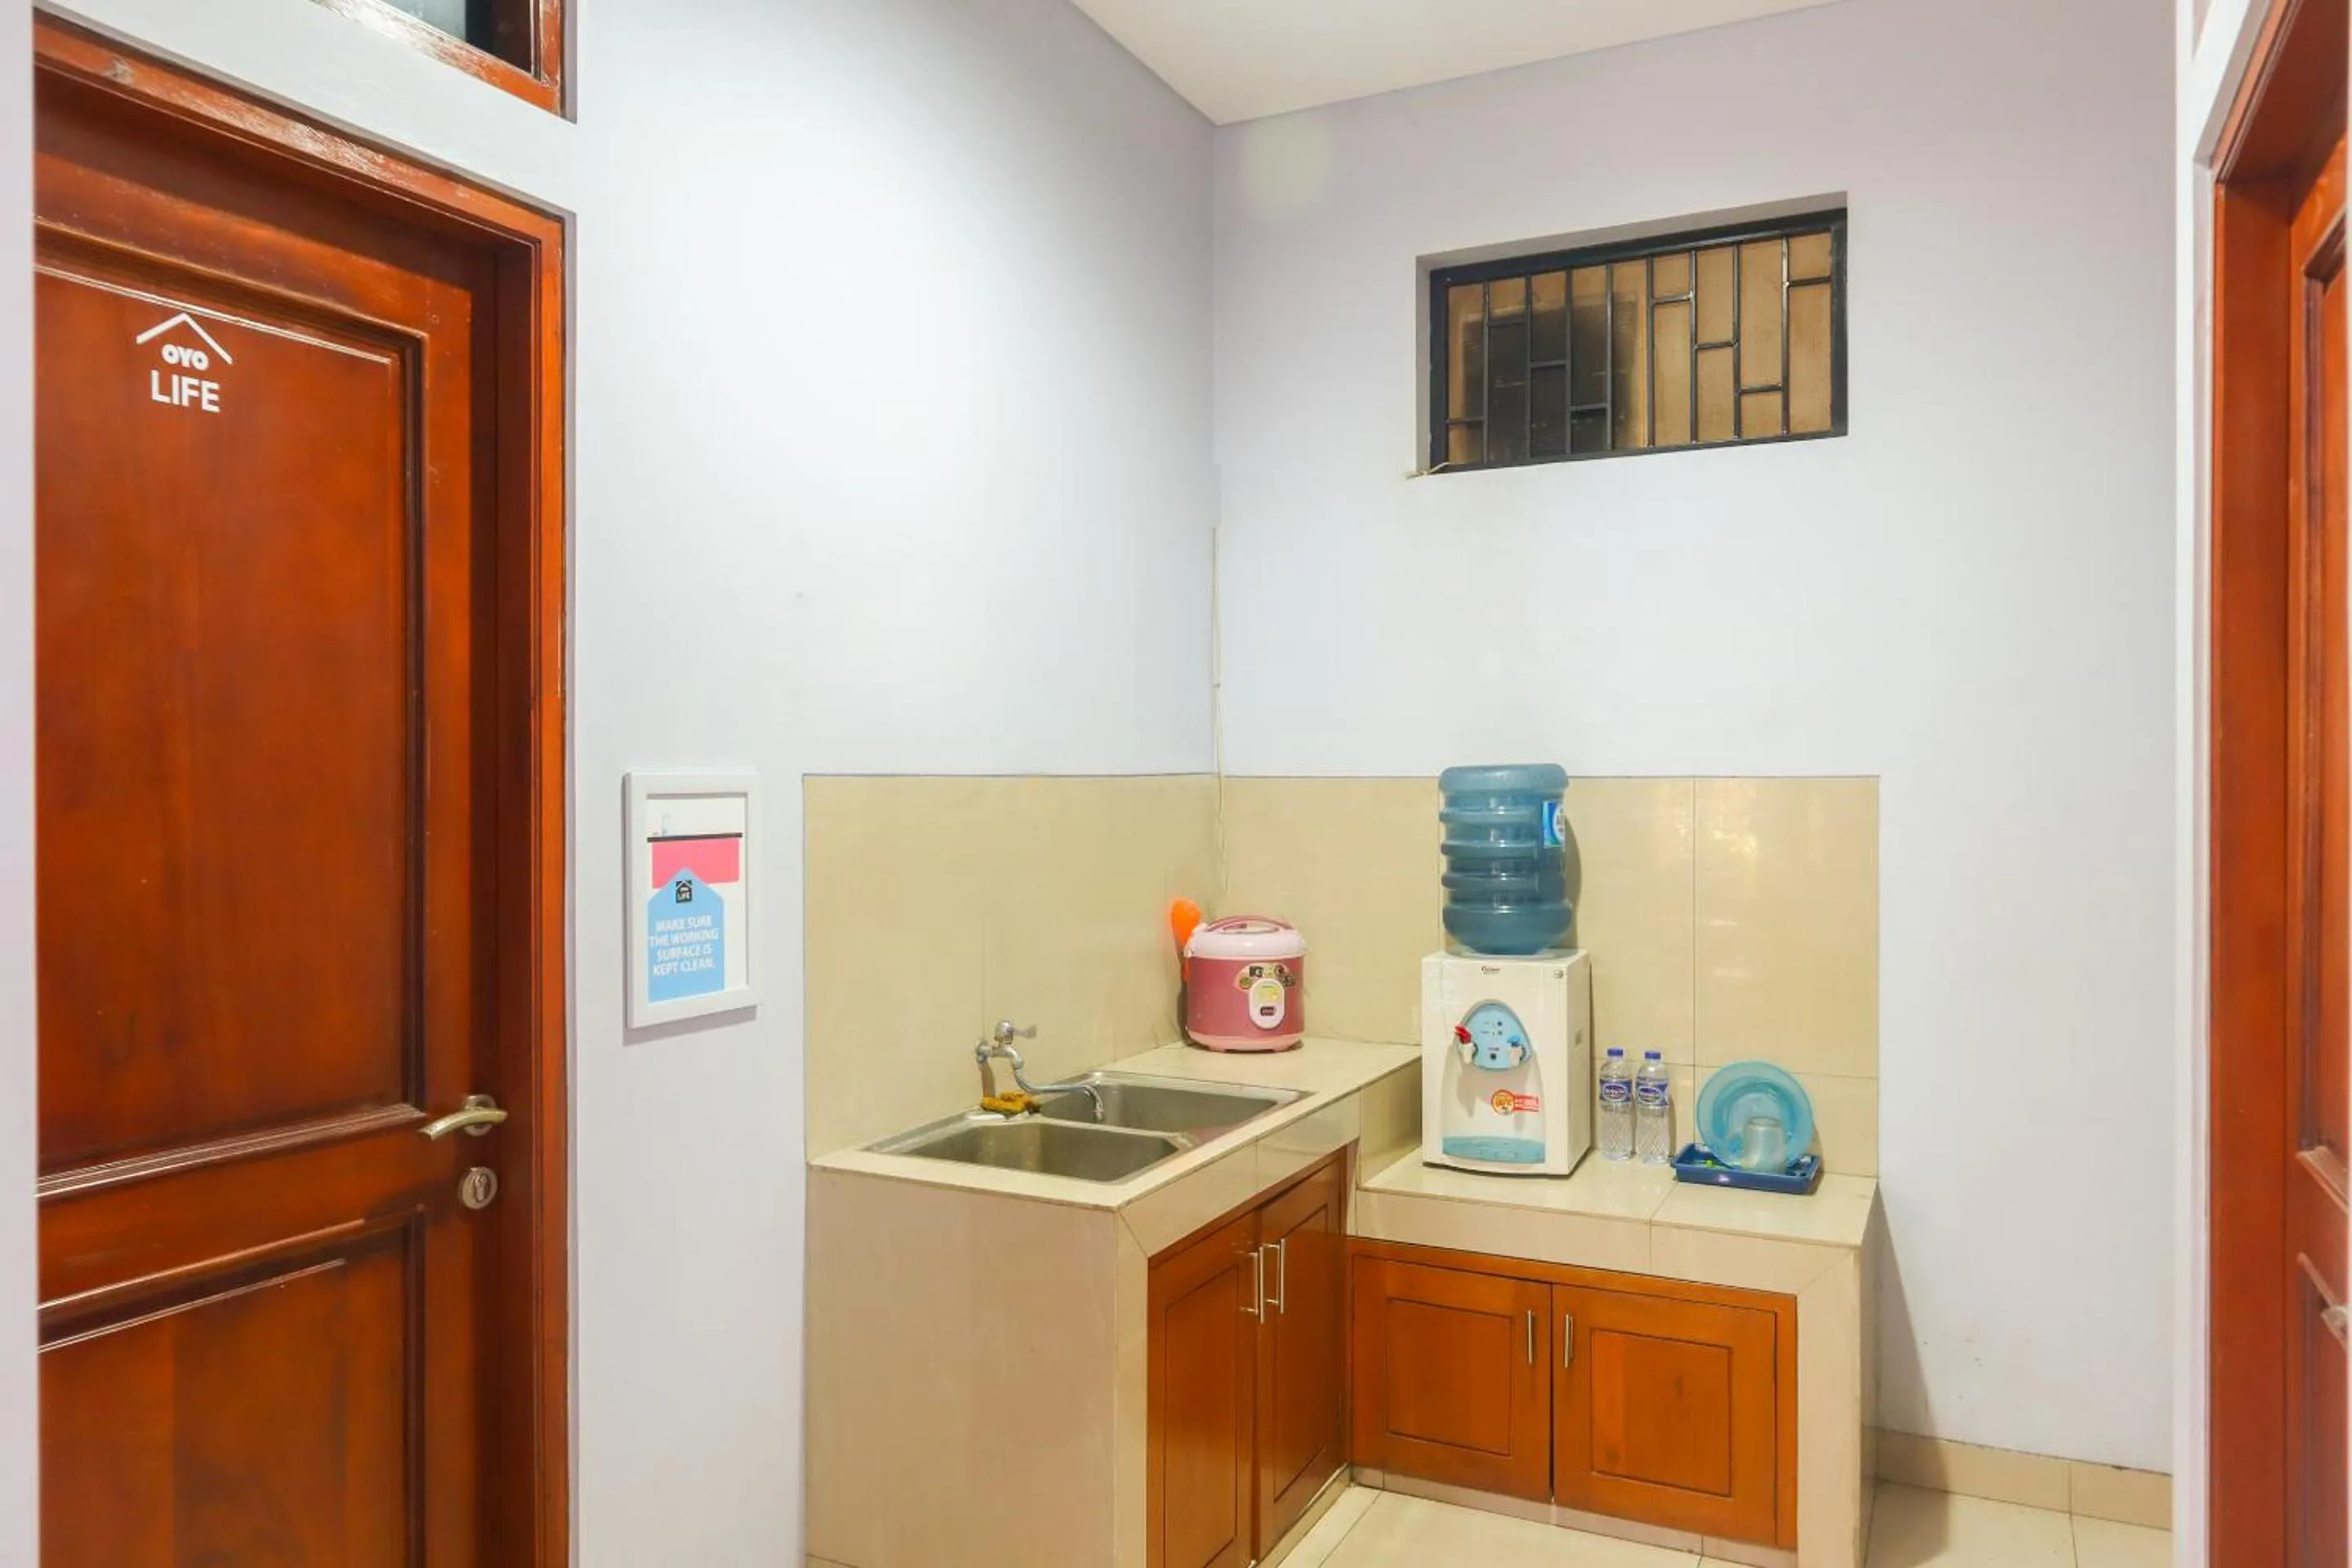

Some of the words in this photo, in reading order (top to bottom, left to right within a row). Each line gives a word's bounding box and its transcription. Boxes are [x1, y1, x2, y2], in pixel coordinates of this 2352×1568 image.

[162, 344, 209, 371] OYO
[150, 369, 220, 413] LIFE
[656, 917, 684, 932] MAKE
[688, 915, 713, 928] SURE
[648, 934, 669, 947] THE
[670, 928, 719, 945] WORKING
[657, 946, 702, 961] SURFACE
[703, 942, 712, 955] IS
[653, 961, 678, 977] KEPT
